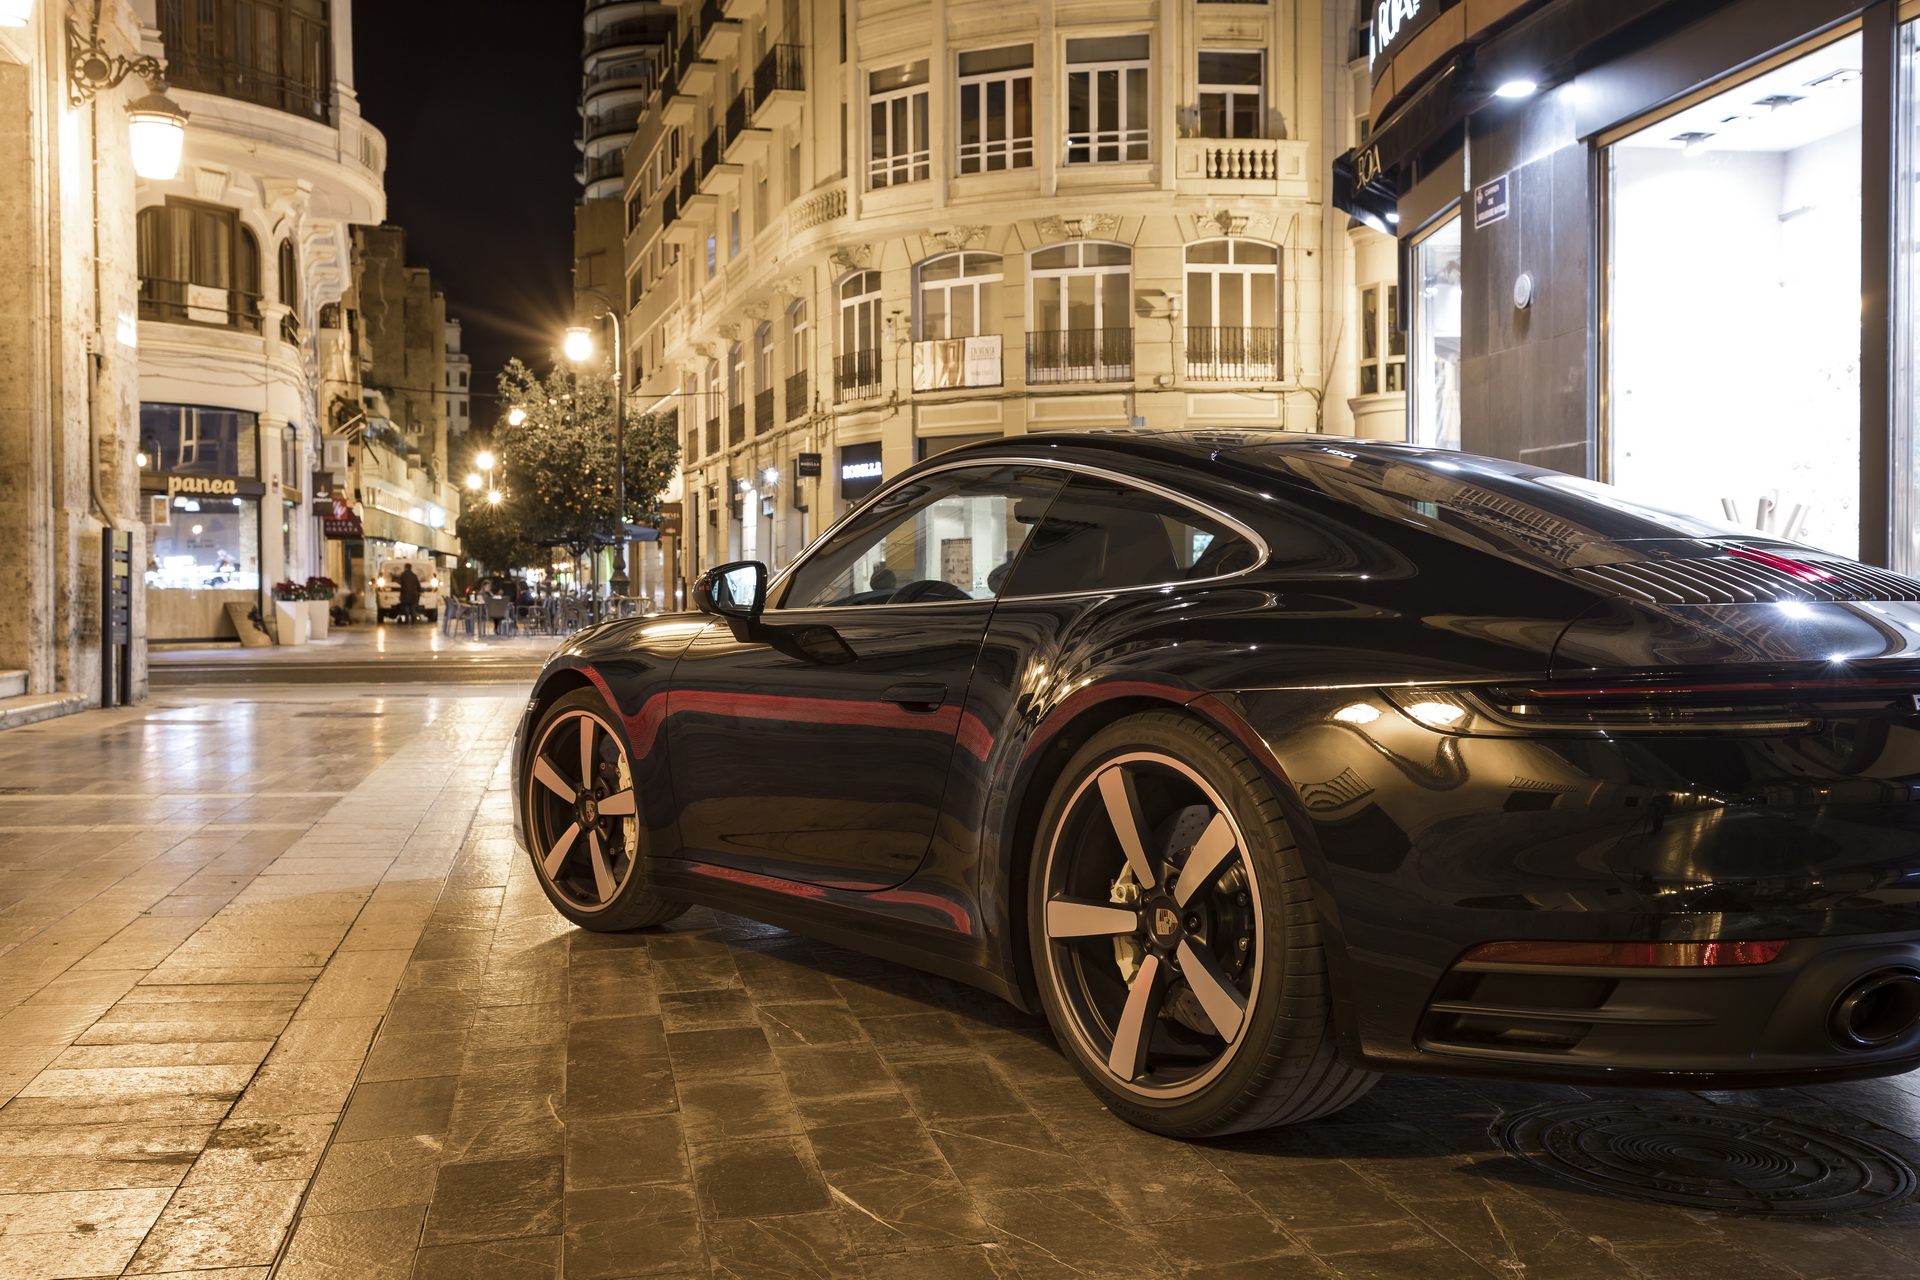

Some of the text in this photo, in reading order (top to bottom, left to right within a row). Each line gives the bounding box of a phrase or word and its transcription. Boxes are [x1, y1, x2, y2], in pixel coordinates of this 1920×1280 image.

[1357, 144, 1381, 189] ROA
[971, 346, 995, 355] EN VENTA
[168, 476, 239, 498] panea
